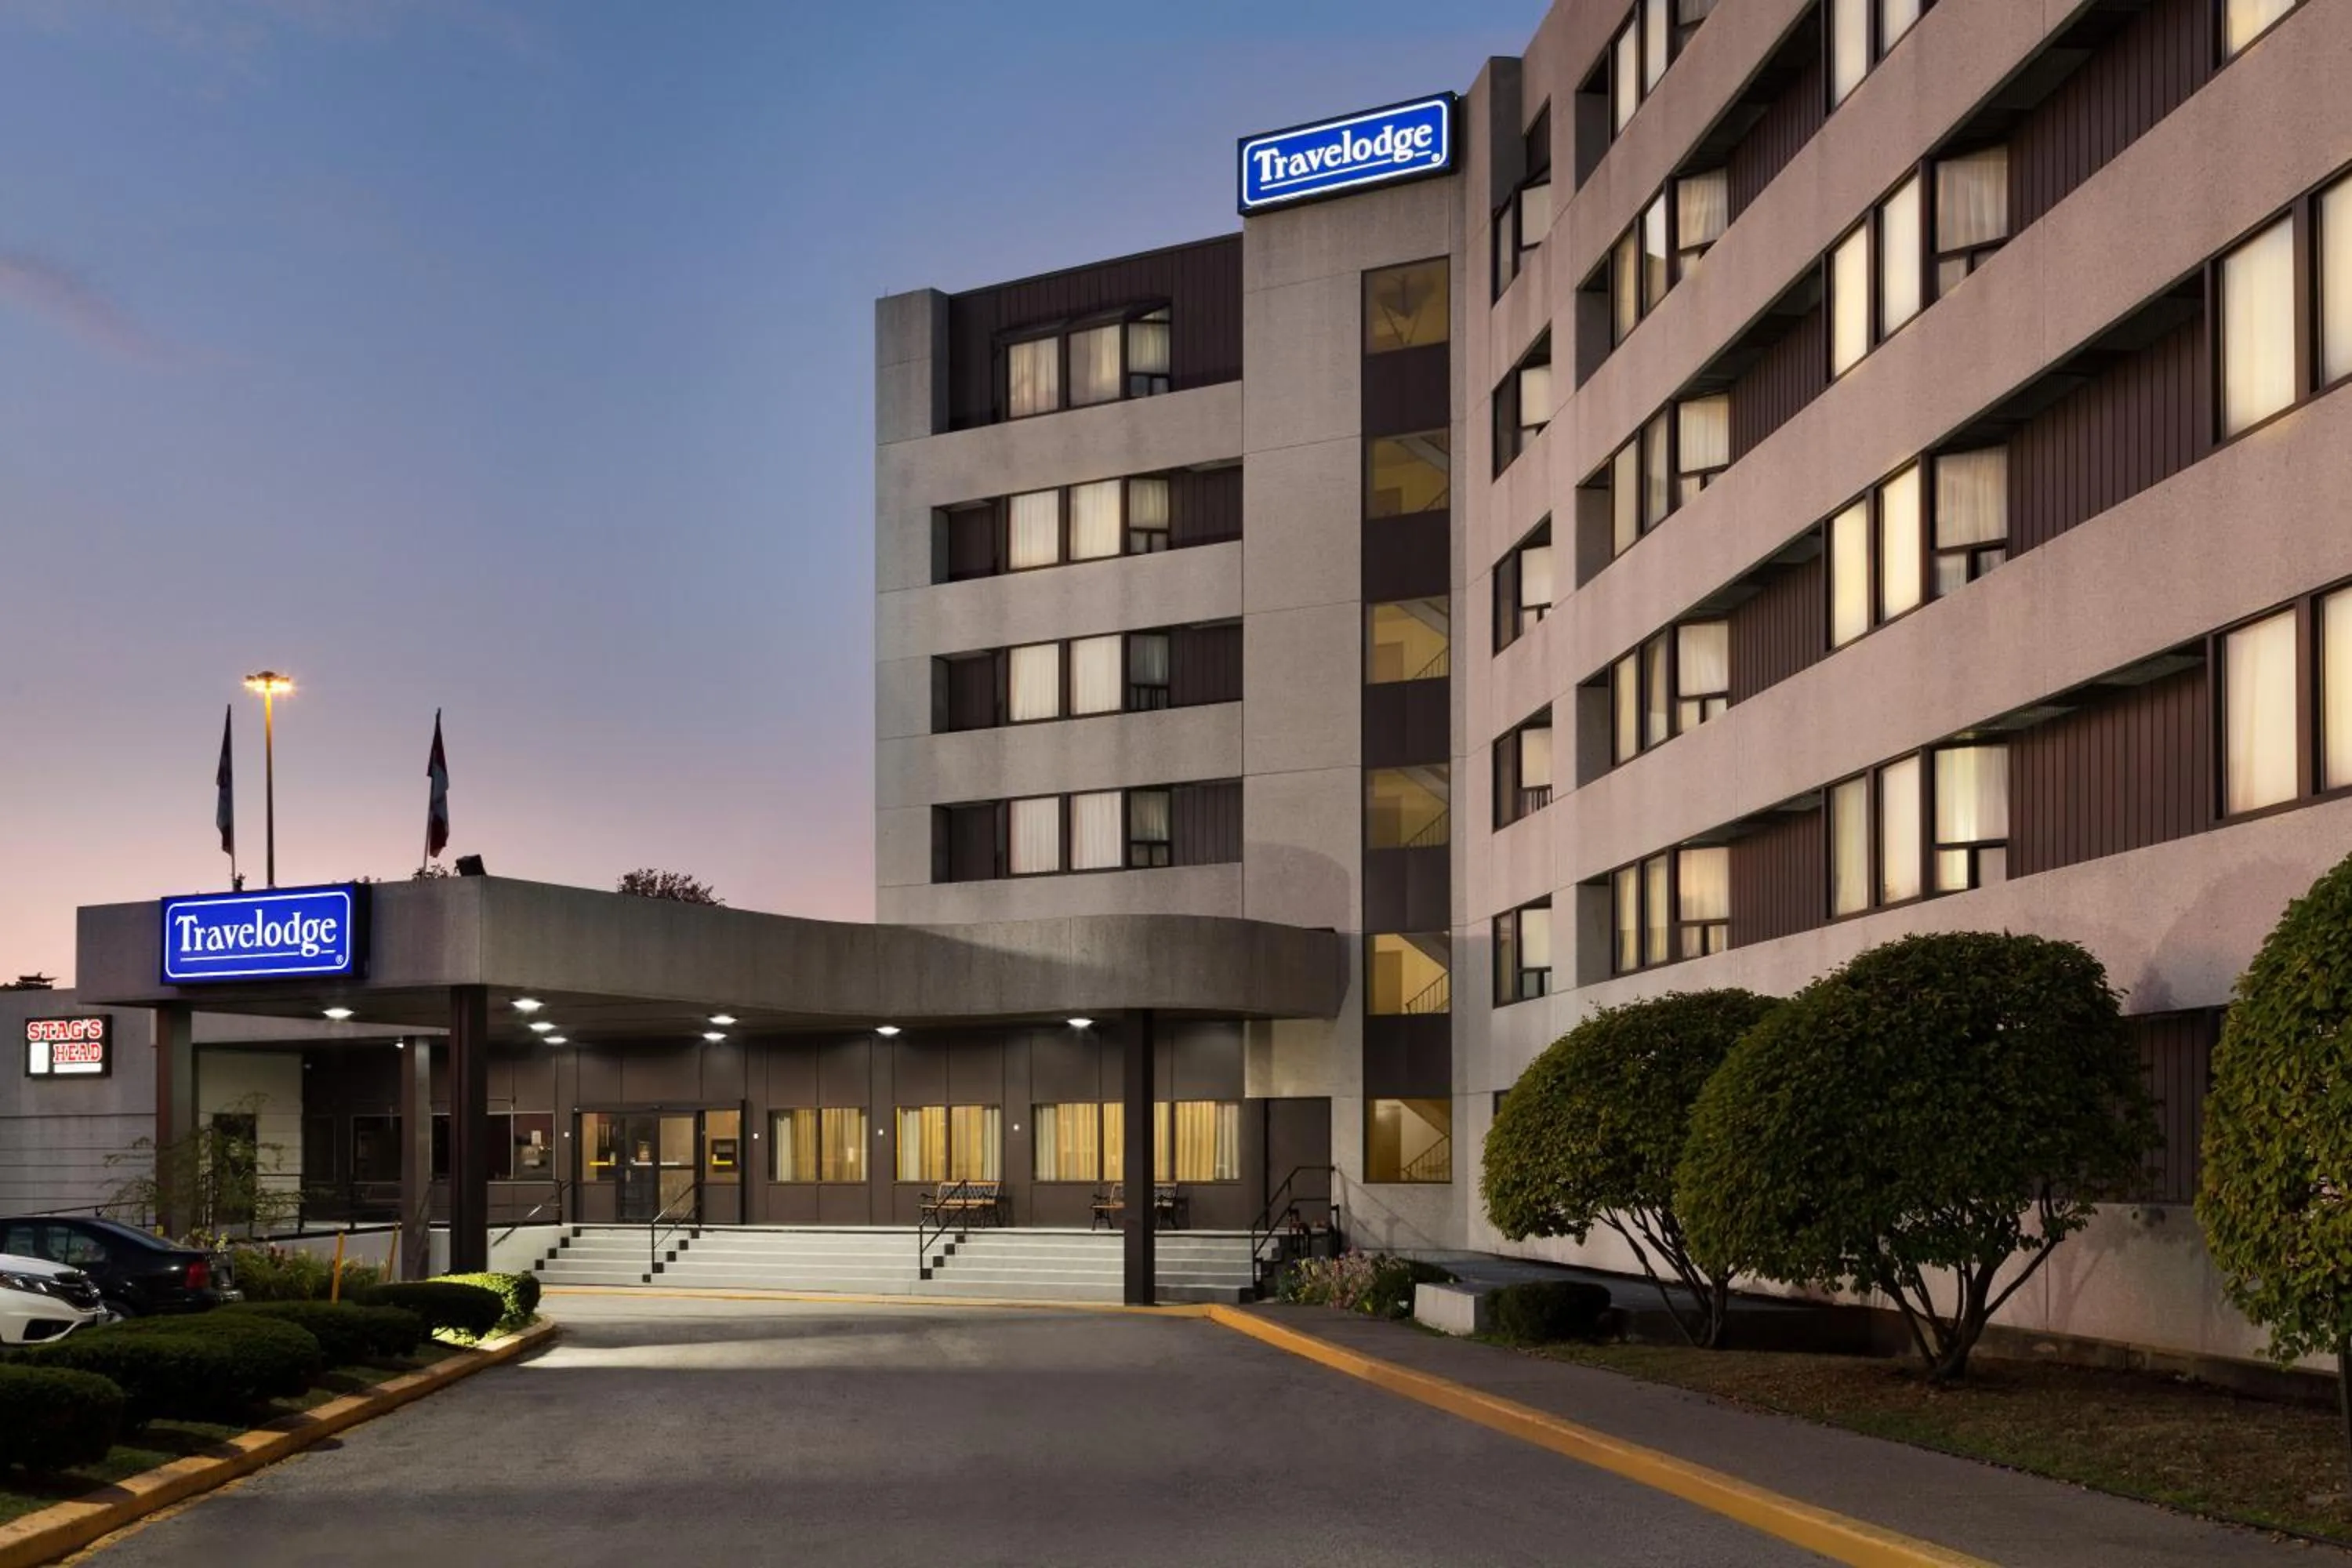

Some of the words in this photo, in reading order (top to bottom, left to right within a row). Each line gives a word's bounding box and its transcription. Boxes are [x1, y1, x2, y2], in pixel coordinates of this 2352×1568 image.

[1254, 124, 1433, 183] Travelodge
[175, 909, 338, 957] Travelodge
[27, 1019, 103, 1040] STAG'S
[53, 1042, 102, 1062] HEAD
